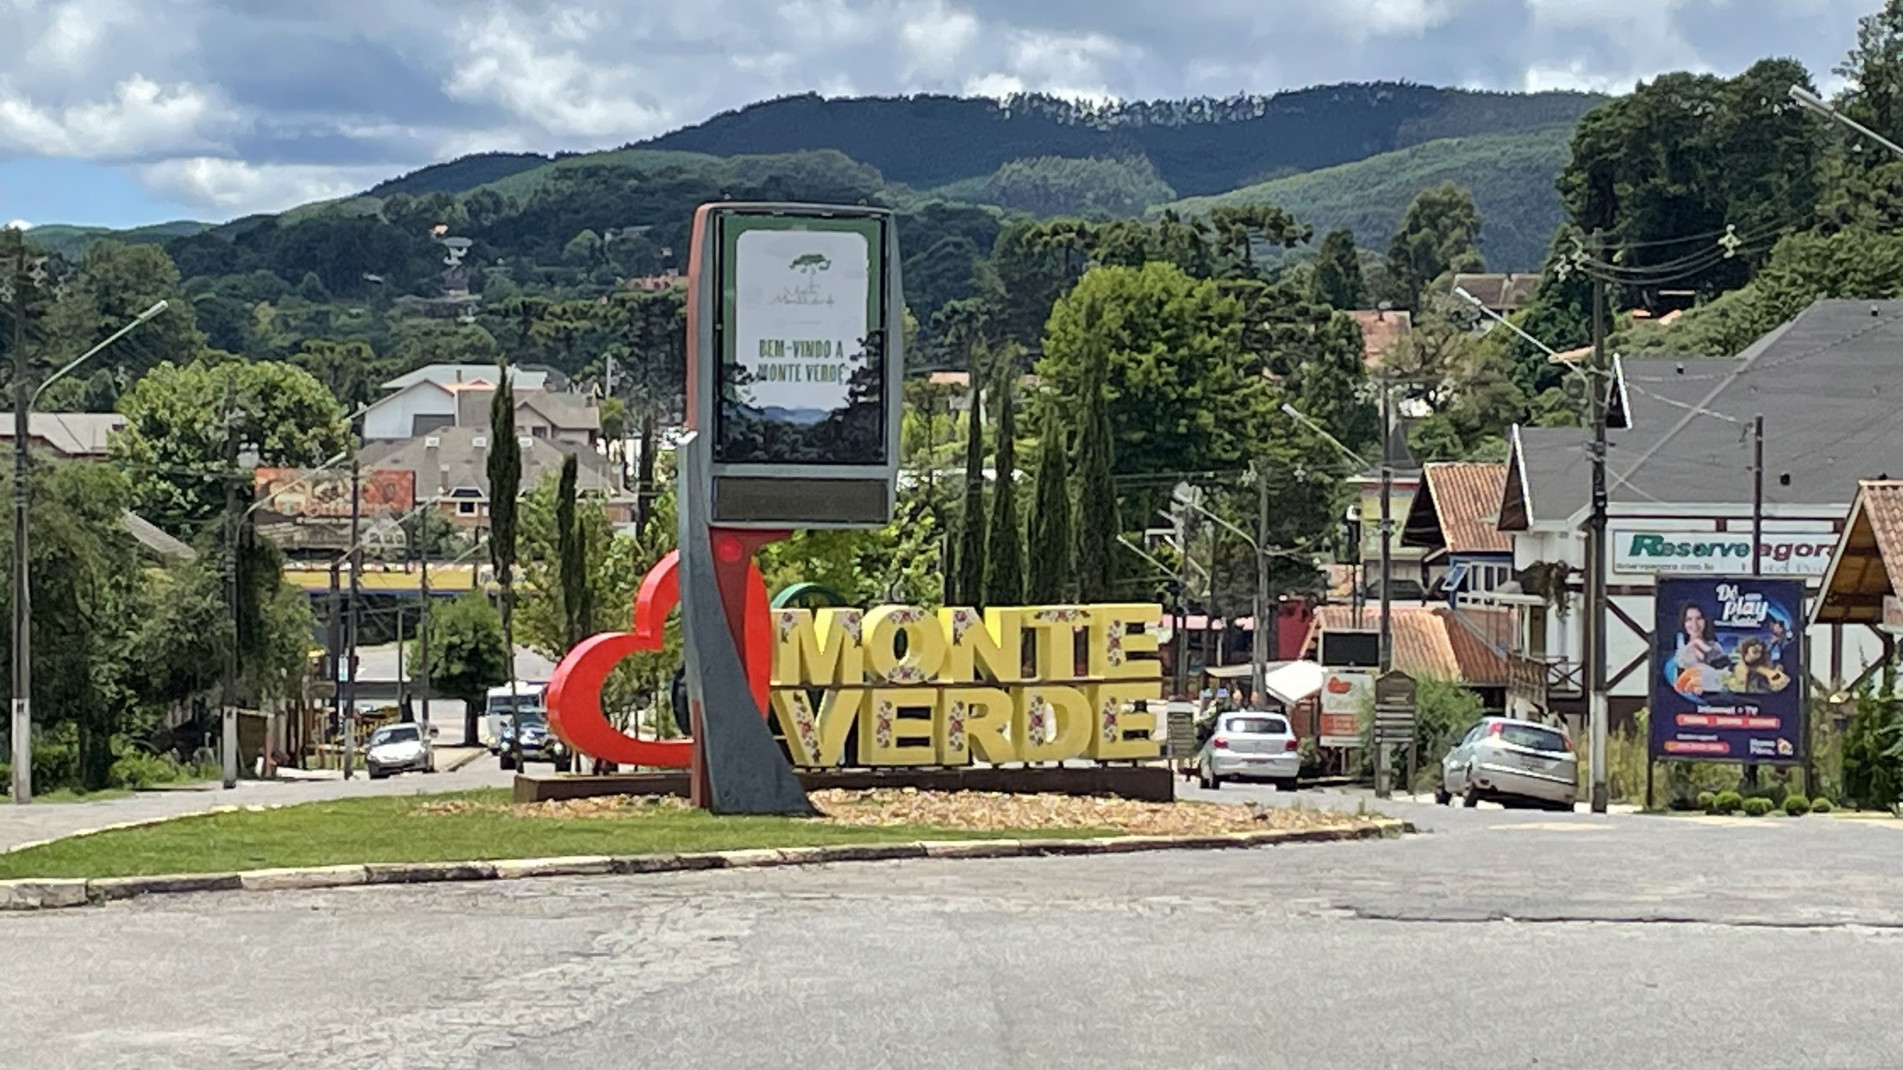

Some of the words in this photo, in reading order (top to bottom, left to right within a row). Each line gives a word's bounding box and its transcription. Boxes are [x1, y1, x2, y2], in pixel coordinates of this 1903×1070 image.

[758, 363, 802, 382] MONTE
[759, 339, 832, 358] BEM-VINDO
[836, 340, 844, 358] A
[771, 604, 1163, 685] MONTE
[771, 681, 1163, 766] VERDE
